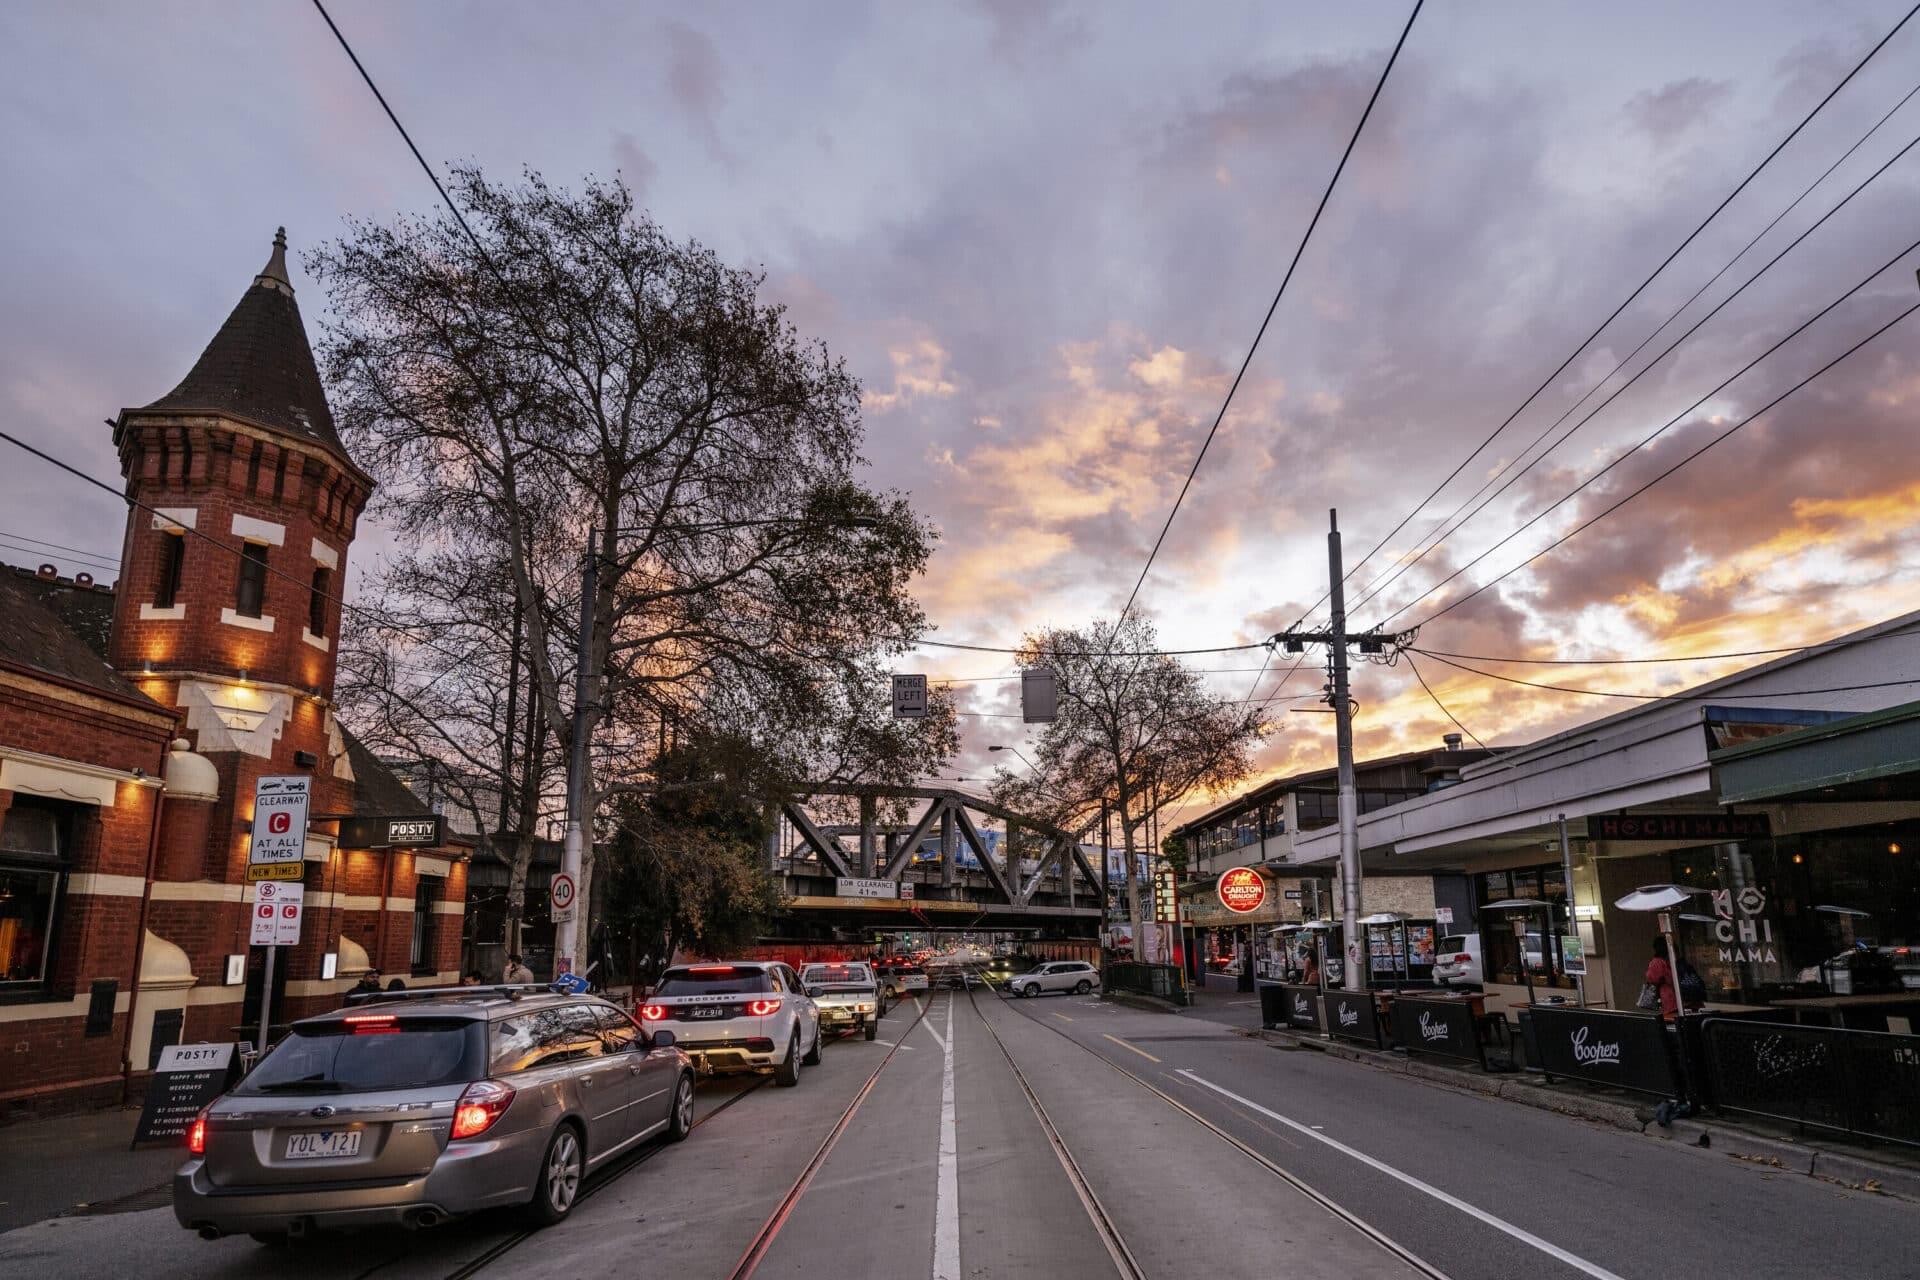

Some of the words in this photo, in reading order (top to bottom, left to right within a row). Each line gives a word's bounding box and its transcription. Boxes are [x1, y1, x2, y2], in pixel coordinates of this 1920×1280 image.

[896, 677, 923, 688] MERGE
[898, 690, 921, 701] LEFT
[259, 795, 305, 806] CLEARWAY
[273, 814, 285, 832] C
[391, 823, 433, 835] POSTY
[257, 839, 273, 848] AT
[277, 838, 299, 847] ALL
[261, 849, 293, 859] TIMES
[252, 868, 270, 877] NEW
[275, 866, 298, 876] TIMES
[856, 880, 894, 889] CLEARANCE
[1223, 886, 1262, 894] CARLTON
[555, 884, 570, 899] 40
[1716, 919, 1773, 943] CHI
[1719, 949, 1777, 963] MAMA
[677, 995, 737, 1003] DISCOVERY
[1419, 1011, 1449, 1041] Coopers
[1571, 1026, 1620, 1065] Coopers
[175, 1049, 218, 1060] POSTY
[290, 1136, 316, 1153] YOL
[331, 1134, 357, 1151] 121
